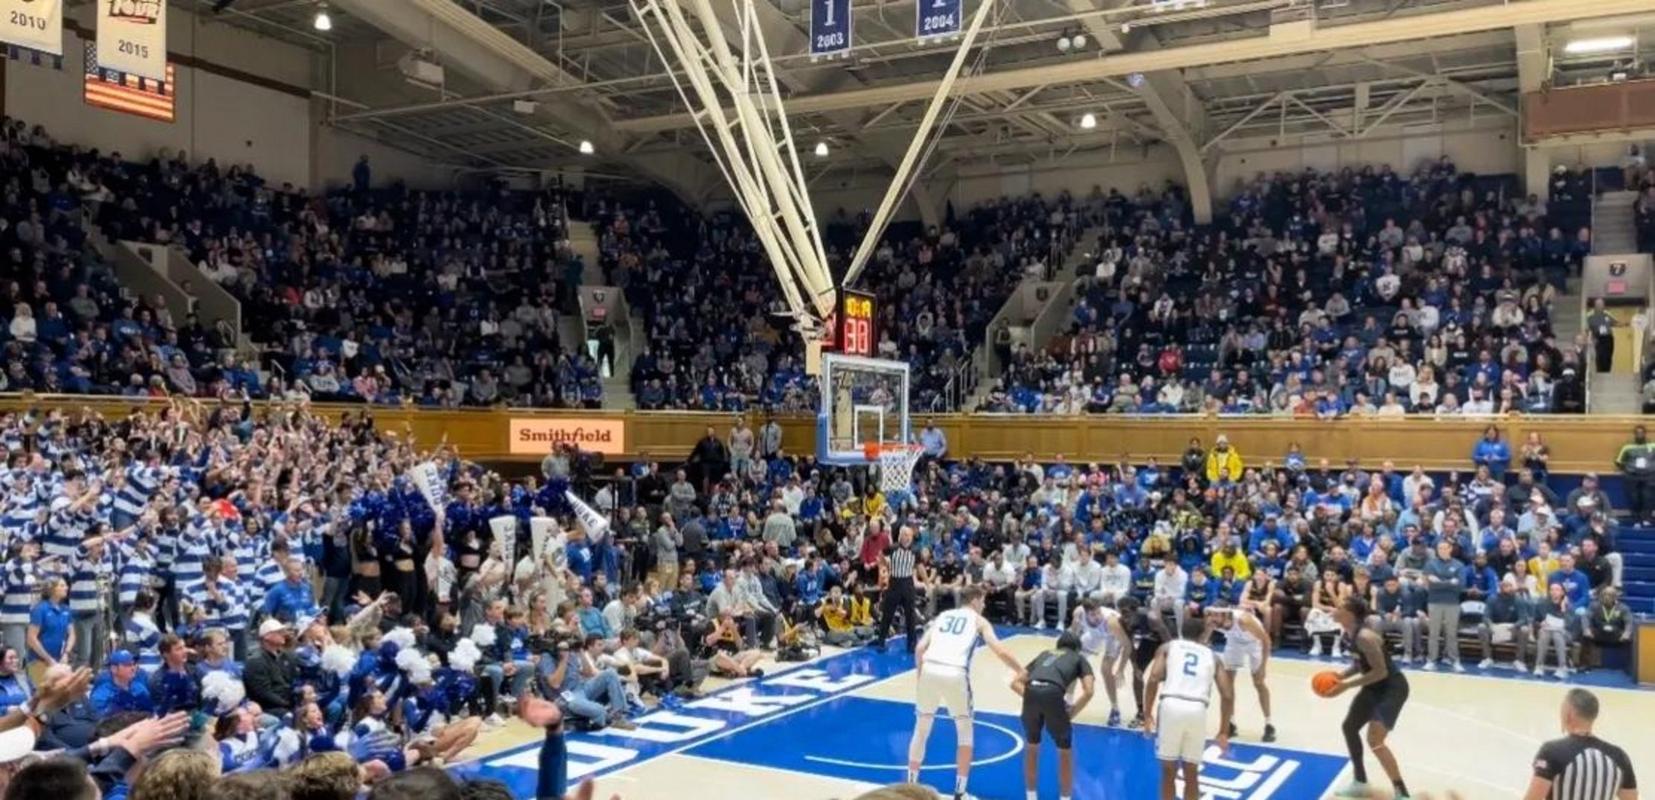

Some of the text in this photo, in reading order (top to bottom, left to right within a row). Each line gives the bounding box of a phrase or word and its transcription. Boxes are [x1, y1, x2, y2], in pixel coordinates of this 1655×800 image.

[10, 11, 46, 30] 2010
[924, 14, 954, 30] 2004
[118, 39, 149, 58] 2015
[816, 32, 844, 48] 2003
[519, 427, 612, 443] Smithfield
[939, 615, 967, 635] 30
[1183, 652, 1199, 677] 2
[486, 669, 880, 782] DUKE
